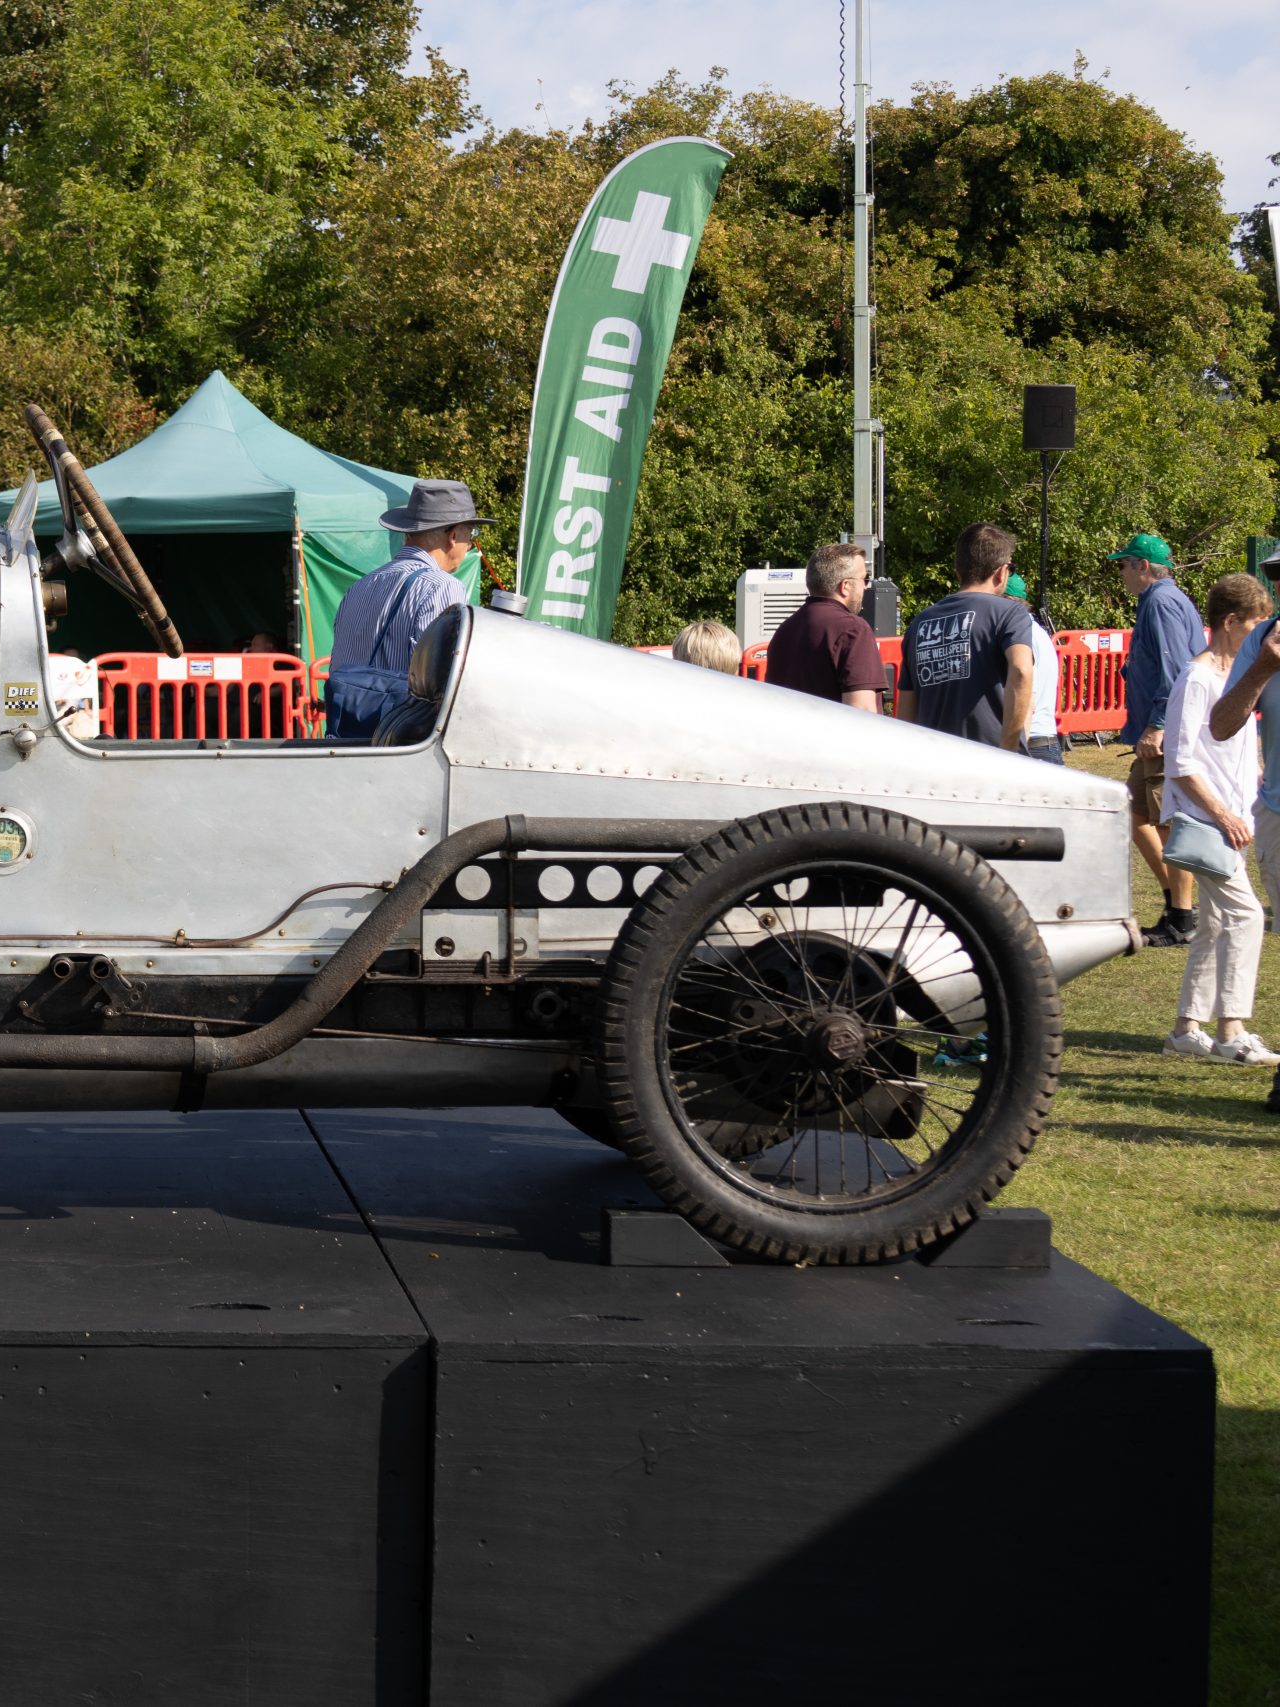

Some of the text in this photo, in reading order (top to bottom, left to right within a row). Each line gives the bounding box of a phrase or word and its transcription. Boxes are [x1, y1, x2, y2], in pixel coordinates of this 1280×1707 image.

[540, 316, 642, 629] IRST AID
[917, 641, 969, 662] TIME WELL SPENT
[6, 686, 36, 699] DIFF
